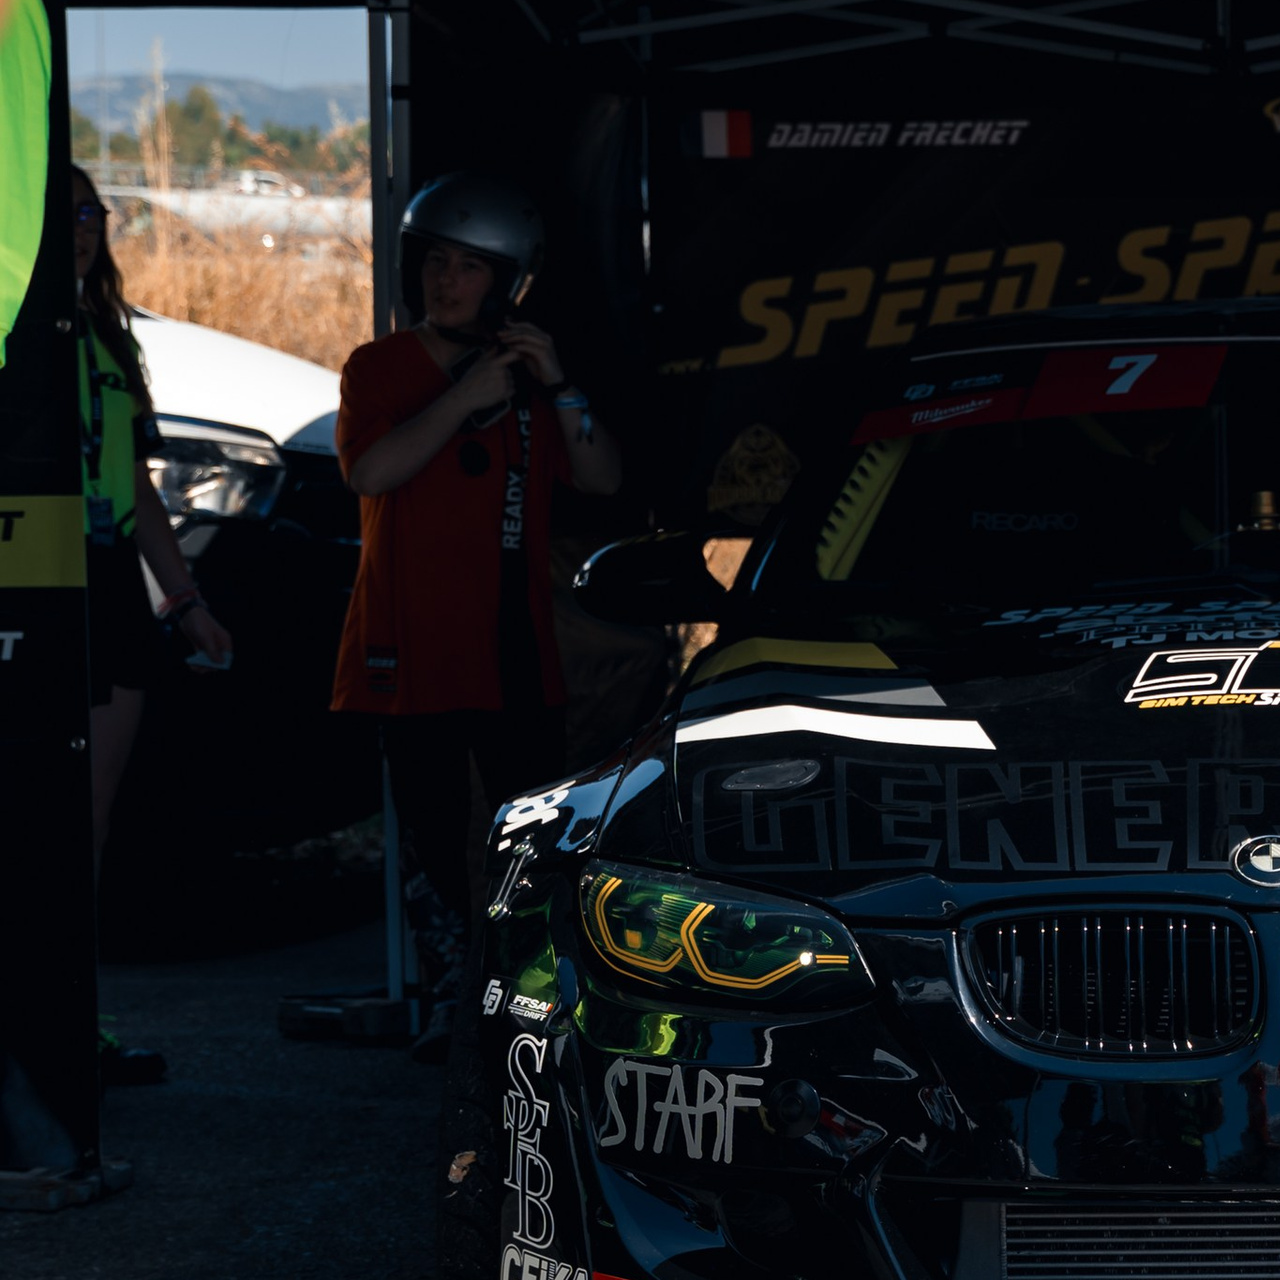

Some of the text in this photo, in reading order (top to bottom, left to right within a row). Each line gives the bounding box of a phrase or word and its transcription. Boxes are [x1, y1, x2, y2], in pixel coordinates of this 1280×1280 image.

[766, 119, 1032, 149] DAMIEN FRECHET
[1104, 352, 1159, 396] 7
[501, 470, 527, 550] READY
[971, 510, 1080, 533] RECARO
[981, 601, 1174, 627] SPEED
[1099, 632, 1168, 650] TJ
[1138, 697, 1184, 710] SIM
[1190, 694, 1257, 706] TECH
